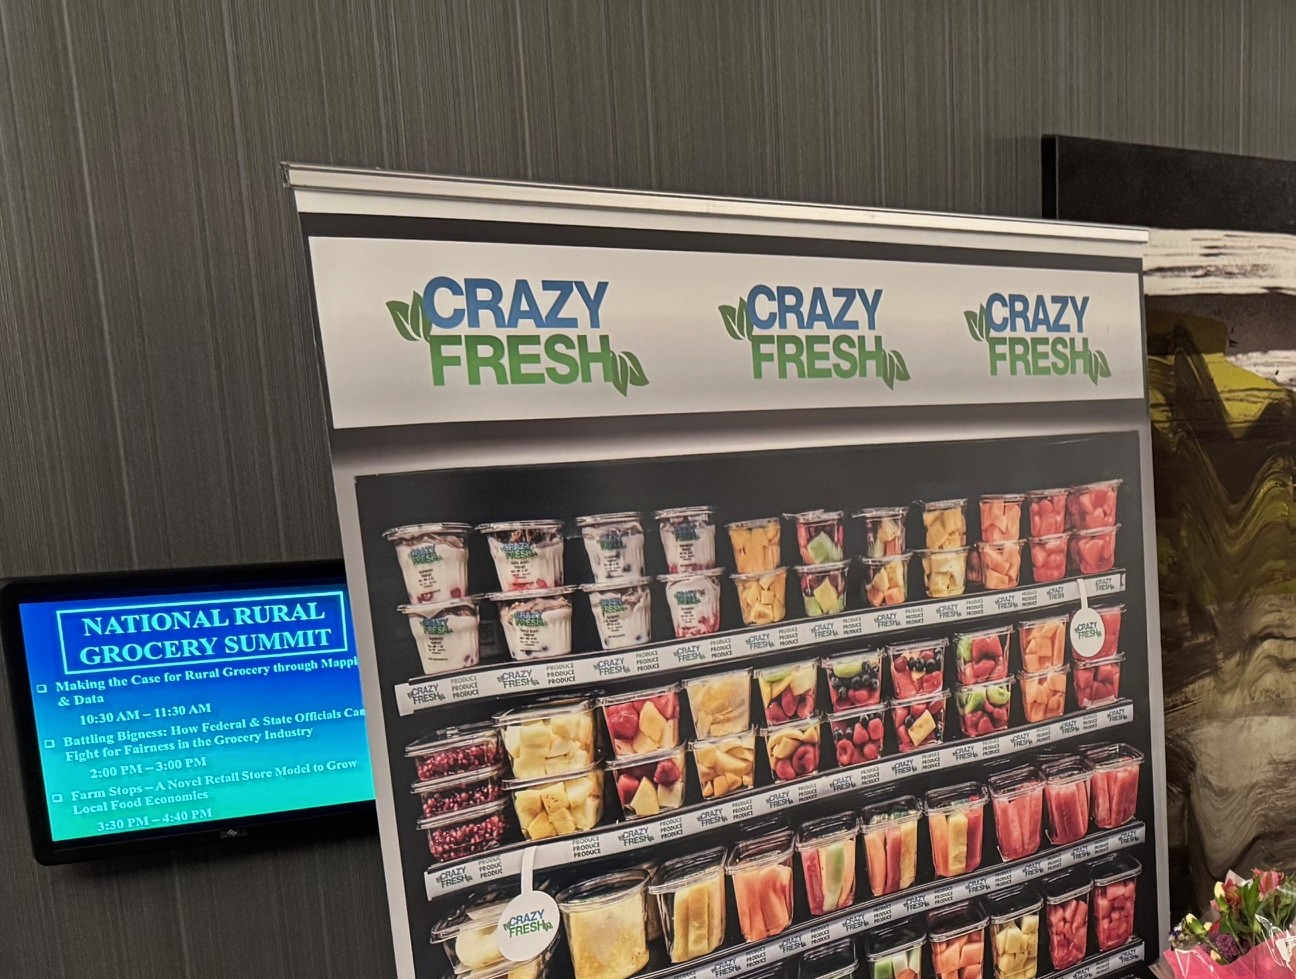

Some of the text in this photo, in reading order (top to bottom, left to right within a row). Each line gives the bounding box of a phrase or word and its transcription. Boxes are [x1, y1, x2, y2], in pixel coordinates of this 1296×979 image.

[423, 276, 609, 329] CRAZY
[747, 284, 883, 331] CRAZY
[985, 292, 1090, 333] CRAZY
[429, 333, 614, 387] FRESH
[752, 334, 883, 380] FRESH
[989, 336, 1089, 377] FRESH
[81, 602, 325, 636] NATIONAL RURAL
[80, 628, 332, 665] GROCERY SUMMIT
[677, 645, 700, 655] CRAZY
[678, 652, 701, 663] FRESH
[599, 657, 625, 667] CRAZY
[599, 664, 626, 676] FRESH
[55, 656, 359, 692] Making the Case for Rural Grocery through Mappi
[502, 670, 533, 680] CRAZY
[502, 677, 534, 688] FRESH
[58, 695, 104, 707] & Data
[412, 684, 439, 696] CRAZY
[412, 691, 440, 704] FRESH
[80, 713, 114, 726] 10:30
[116, 709, 140, 723] AM
[154, 705, 186, 718] 11:30
[188, 703, 212, 715] AM
[63, 708, 366, 747] Battling Bigness: How Federal & State Officials Can
[65, 727, 313, 762] Fight for Fairness in the Grocery Industry
[90, 766, 117, 779] 2:00
[120, 764, 143, 775] PM
[155, 760, 182, 771] 3:00
[184, 756, 207, 768] PM
[71, 789, 106, 802] Farm
[109, 785, 143, 797] Stops
[155, 781, 166, 791] A
[167, 776, 202, 790] Novel
[205, 772, 240, 785] Retail
[242, 769, 273, 781] Store
[275, 764, 310, 777] Model
[313, 763, 324, 772] to
[326, 760, 358, 771] Grow
[72, 790, 209, 815] Local Food Economics
[98, 819, 124, 832] 3:30
[127, 816, 149, 828] PM
[162, 811, 188, 823] 4:40
[191, 808, 213, 819] PM
[623, 827, 649, 839] CRAZY
[623, 834, 650, 846] FRESH
[441, 866, 467, 881] CRAZY
[441, 875, 468, 888] FRESH
[509, 919, 545, 938] FRESH
[510, 909, 545, 927] CRAZY
